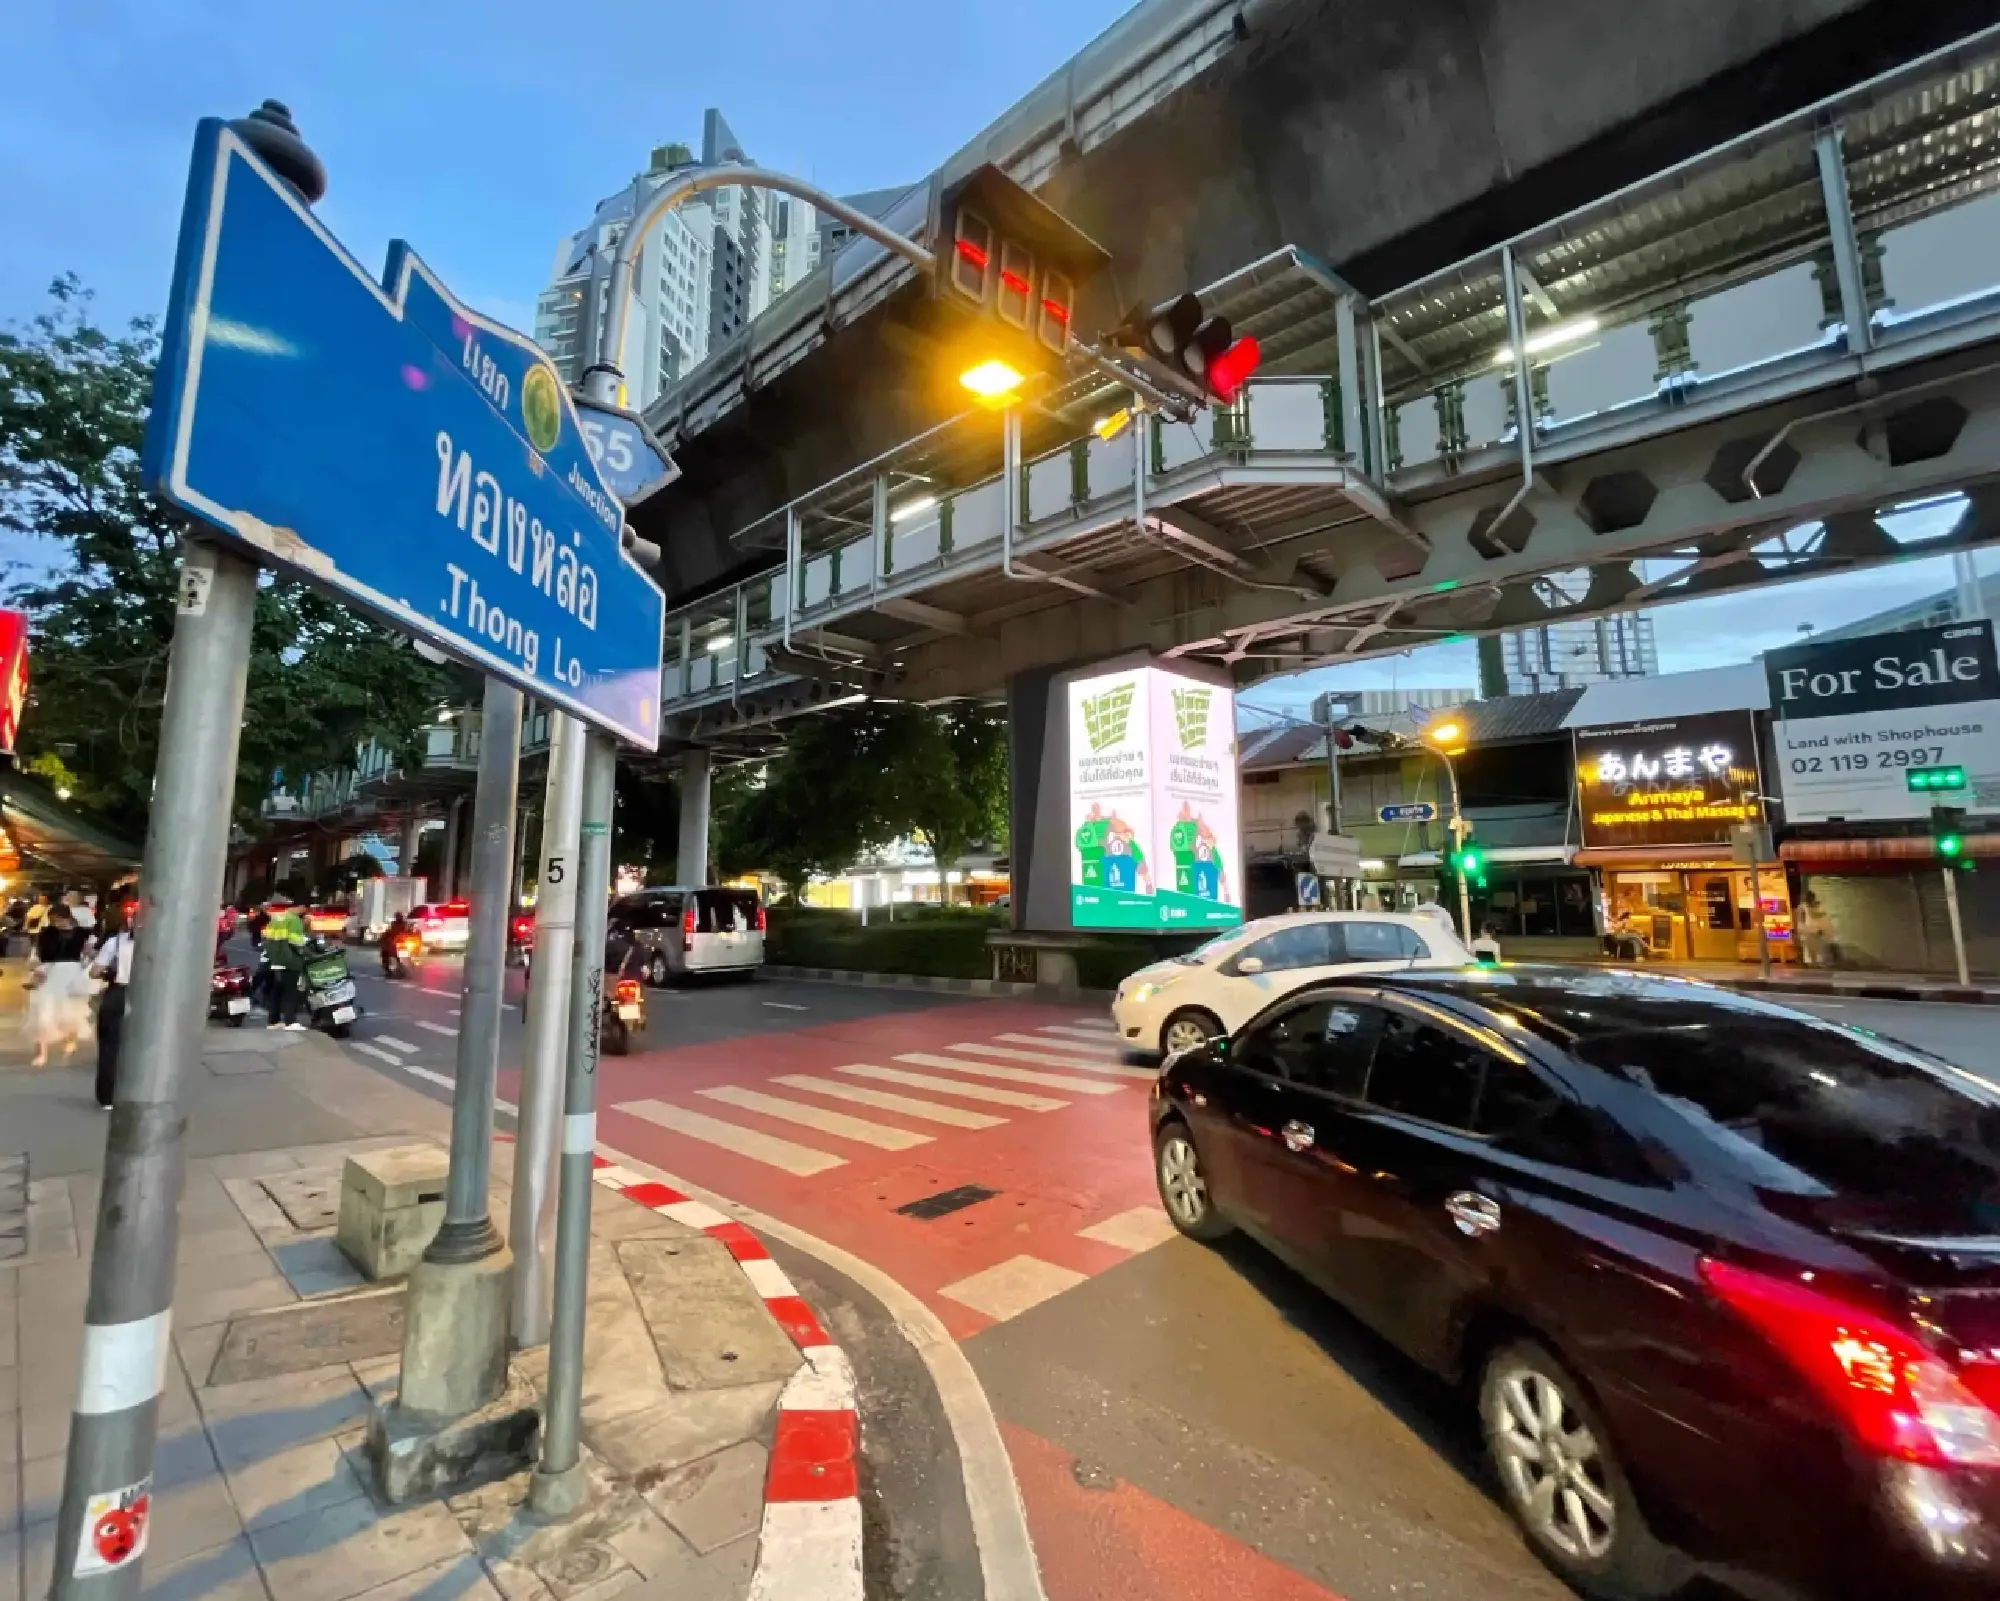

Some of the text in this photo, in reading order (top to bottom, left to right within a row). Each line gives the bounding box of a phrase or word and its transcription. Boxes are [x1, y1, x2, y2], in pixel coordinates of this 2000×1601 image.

[463, 334, 509, 411] แยก
[568, 460, 617, 533] Junction
[436, 430, 598, 632] ทองหล่อ
[1779, 648, 1981, 700] For Sale
[1787, 724, 1984, 750] Land with Shophouse
[1598, 743, 1732, 781] あんまや
[1791, 747, 1944, 774] 02 119 2997
[1628, 790, 1705, 806] Anmaya
[1652, 809, 1663, 821] &
[1664, 807, 1693, 820] Thai
[547, 857, 565, 884] 5
